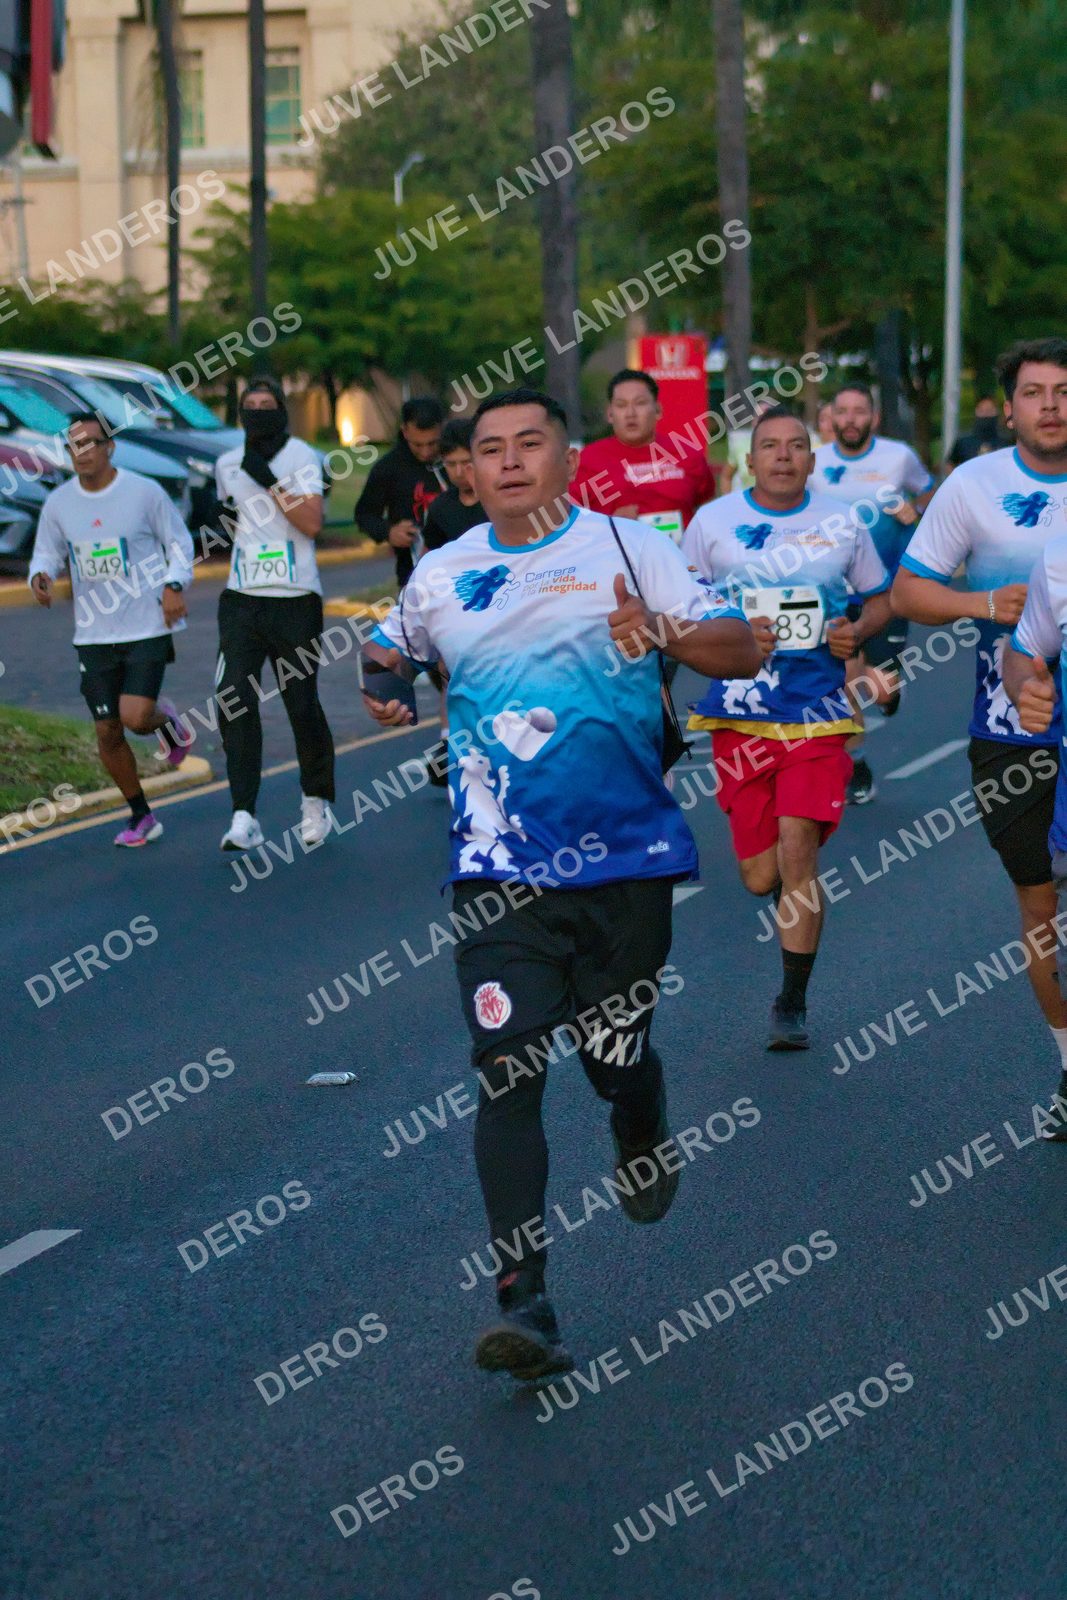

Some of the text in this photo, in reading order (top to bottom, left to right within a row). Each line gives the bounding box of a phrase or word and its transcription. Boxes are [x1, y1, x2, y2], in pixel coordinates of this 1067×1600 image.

[80, 557, 121, 577] 1349
[242, 559, 287, 581] 1790
[525, 566, 577, 583] Carrera
[552, 574, 576, 583] vida
[538, 581, 597, 594] integridad
